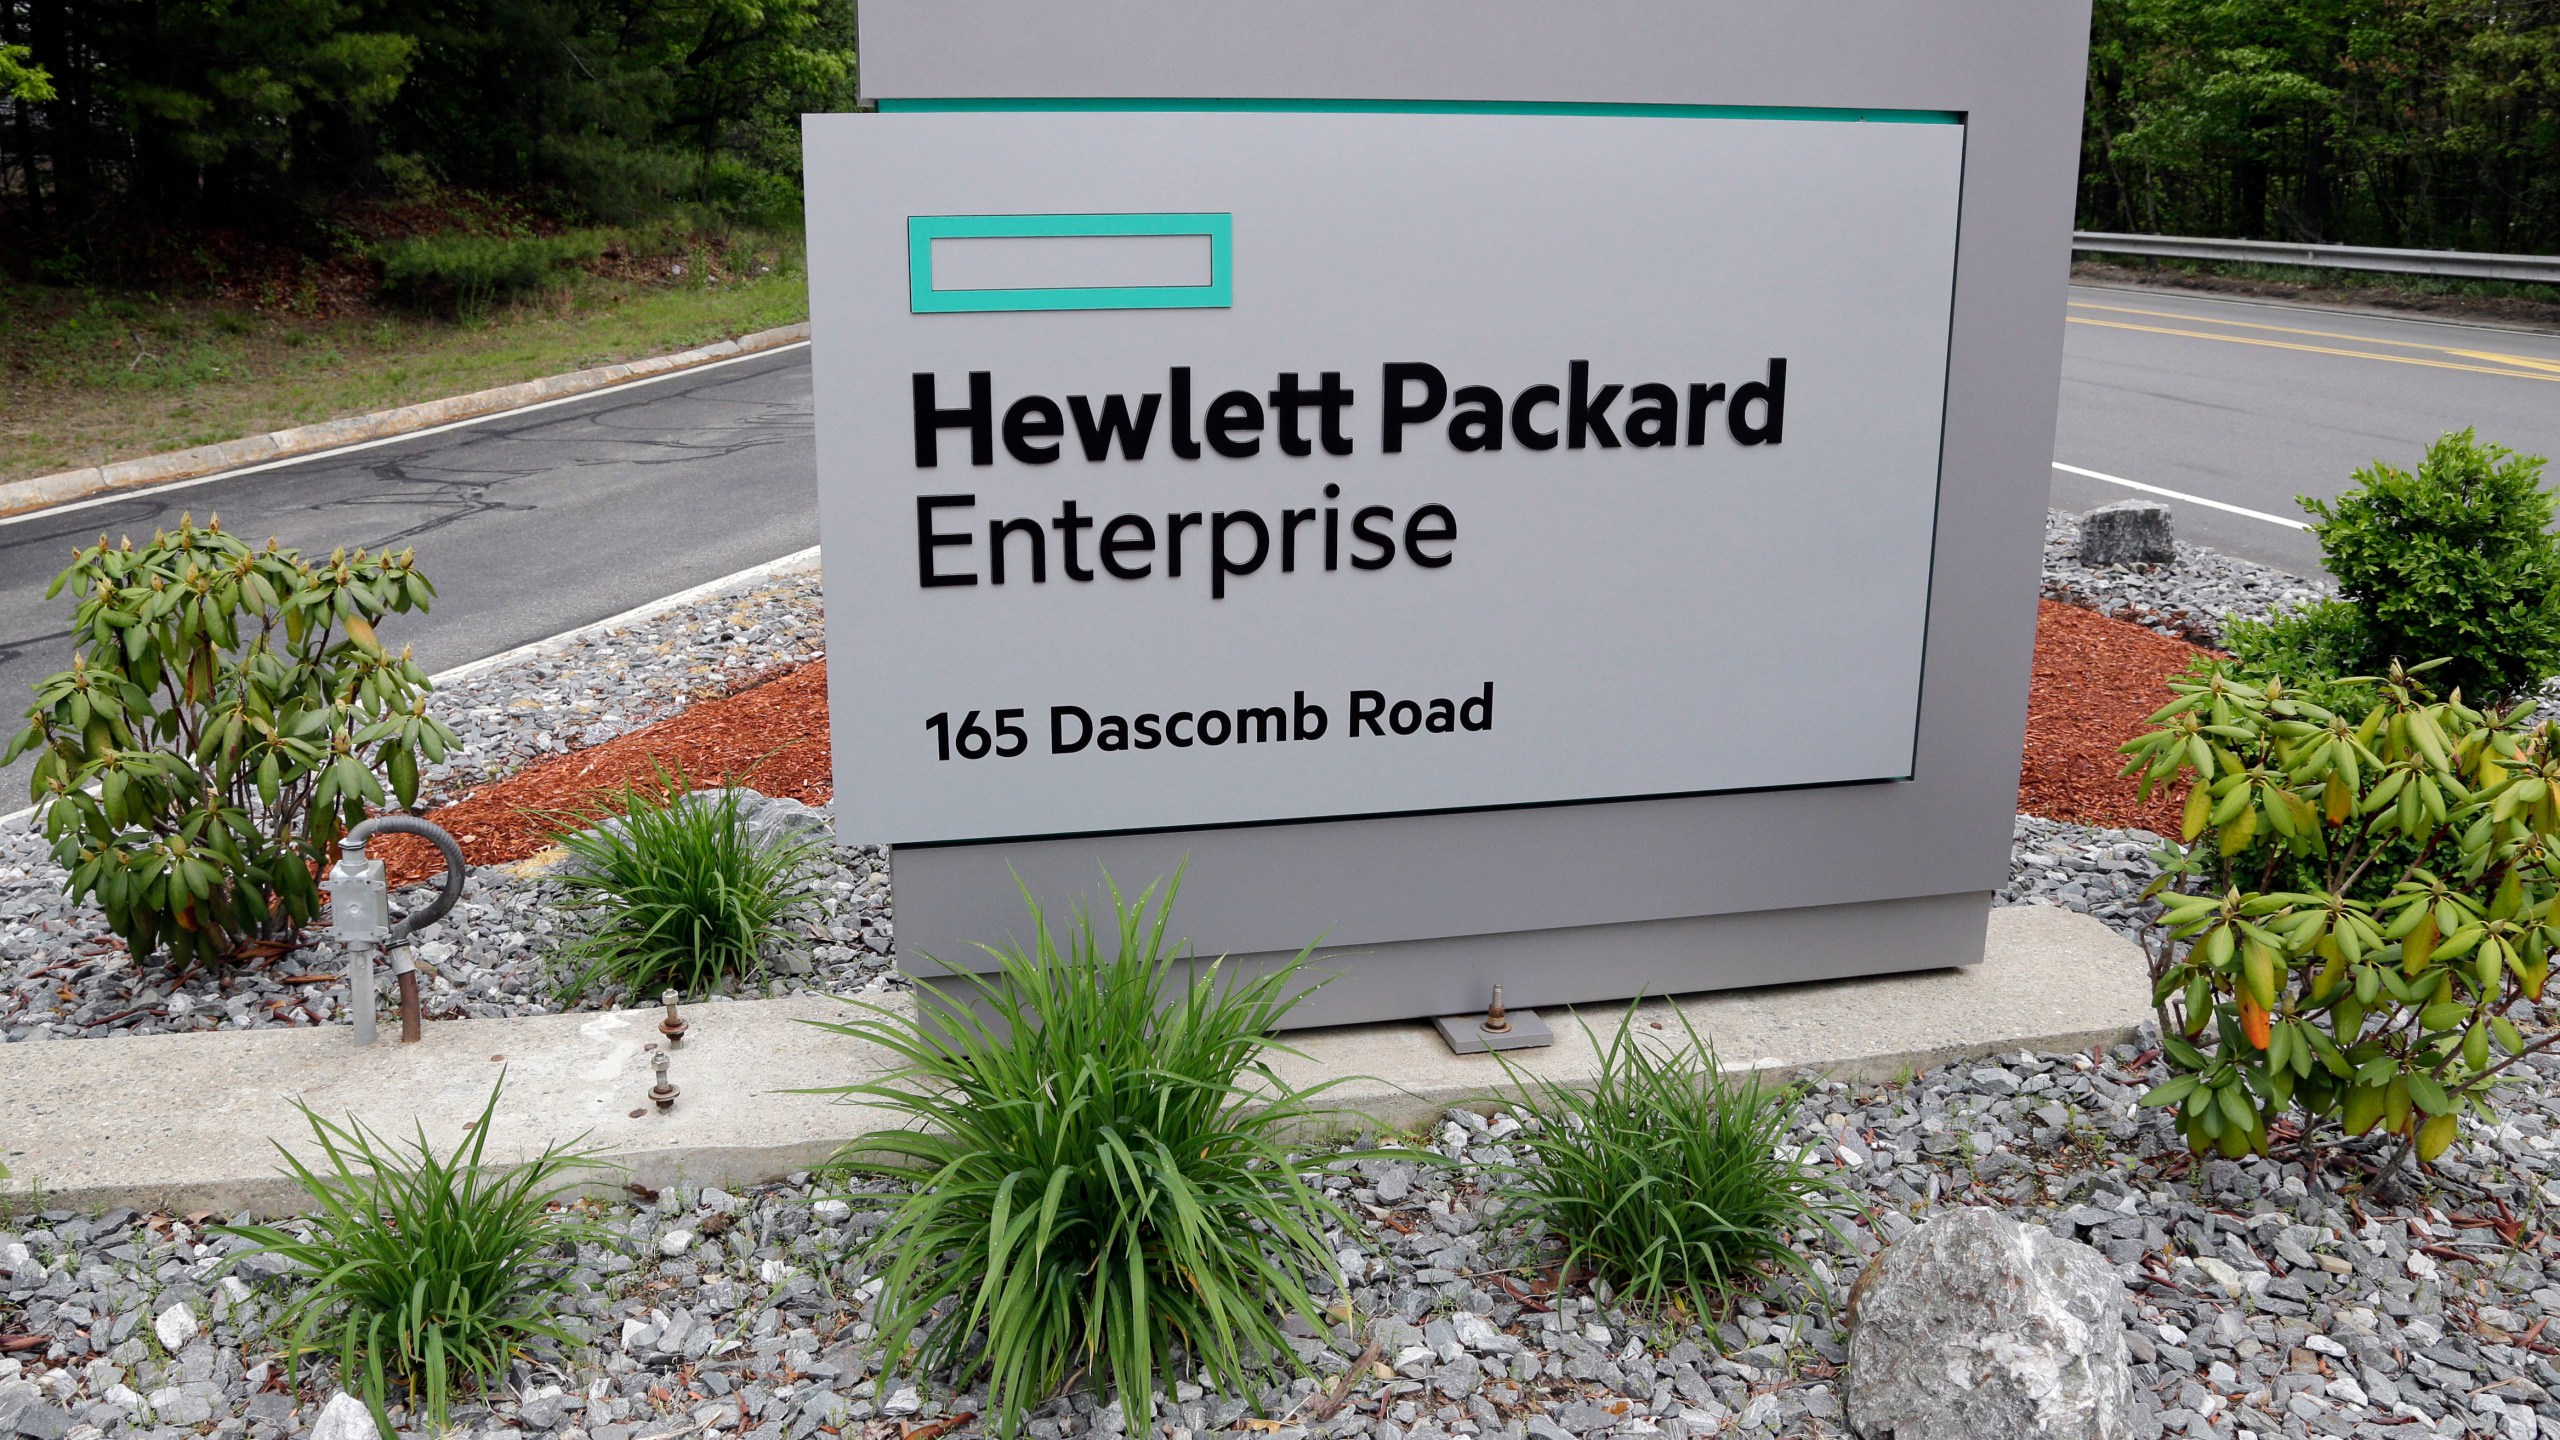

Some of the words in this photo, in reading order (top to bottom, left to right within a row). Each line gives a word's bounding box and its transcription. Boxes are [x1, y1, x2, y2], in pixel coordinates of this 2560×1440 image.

[912, 366, 1354, 469] Hewlett
[1381, 357, 1788, 454] Packard
[916, 483, 1458, 600] Enterprise
[925, 708, 1028, 761] 165
[1050, 690, 1328, 755] Dascomb
[1349, 681, 1494, 738] Road
